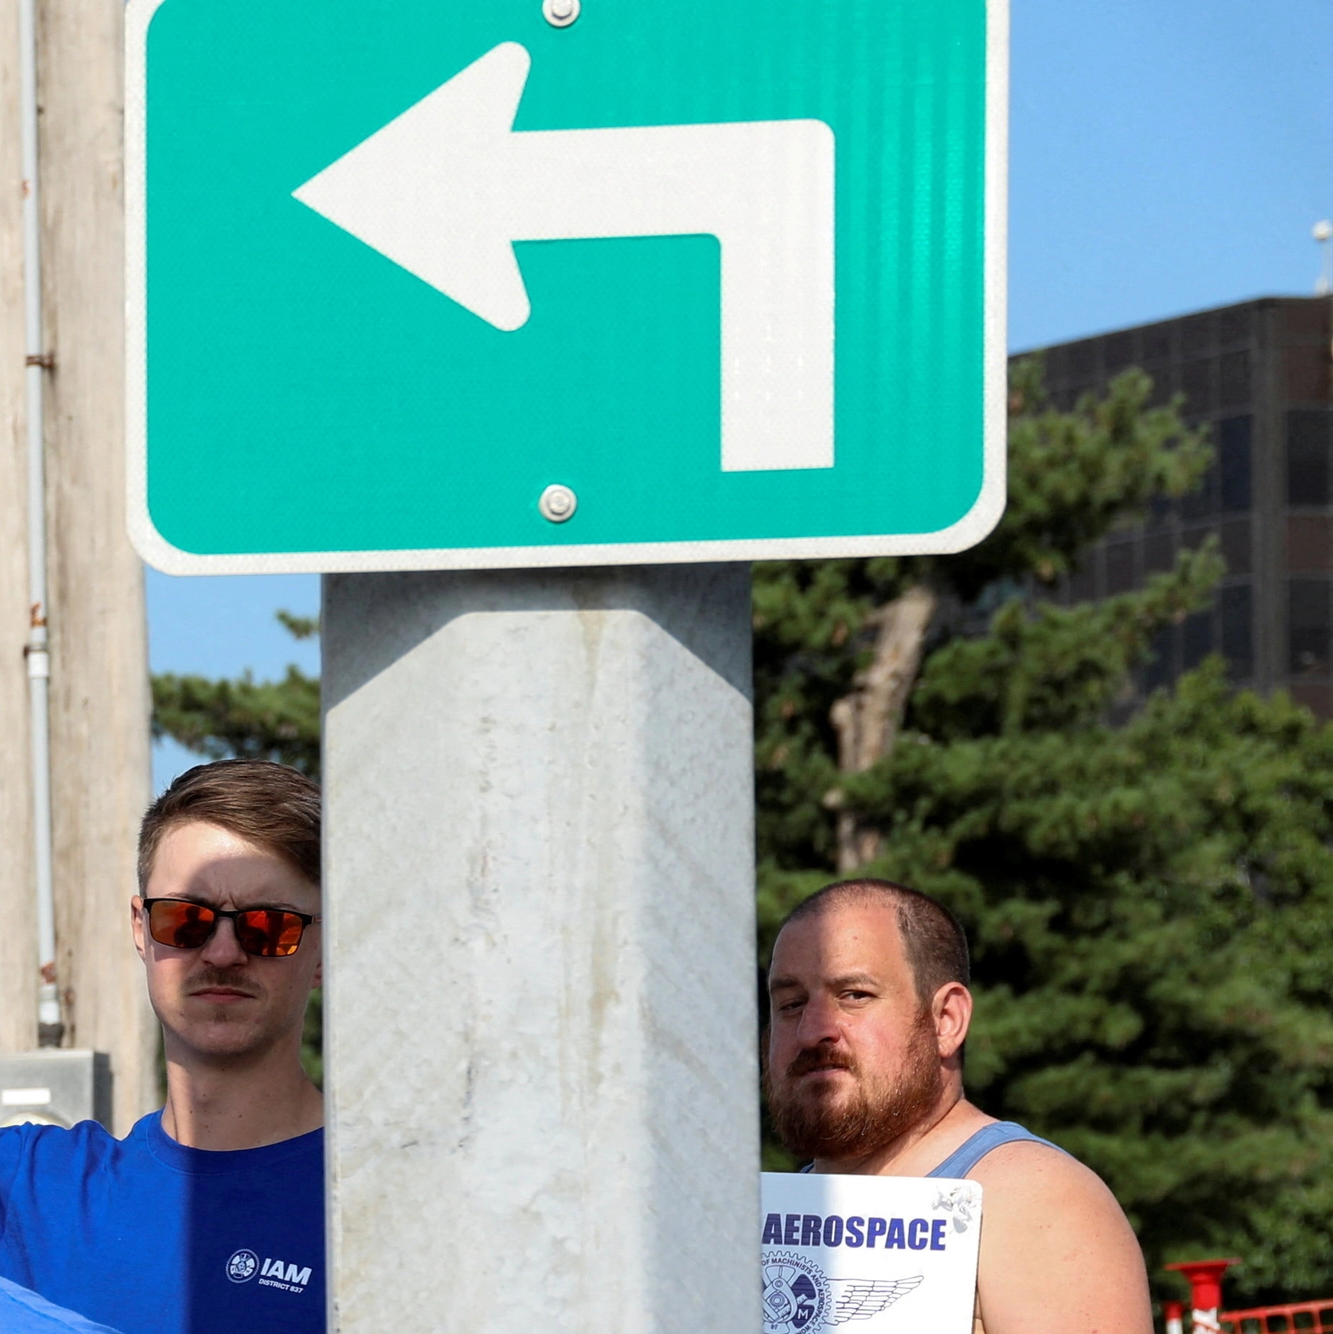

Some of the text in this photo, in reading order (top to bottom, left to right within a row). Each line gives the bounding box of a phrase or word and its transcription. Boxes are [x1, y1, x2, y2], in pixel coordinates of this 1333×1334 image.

[763, 1214, 947, 1251] AEROSPACE
[258, 1278, 290, 1291] DISTRICT
[260, 1258, 312, 1286] IAM
[771, 1257, 813, 1275] MACHINISTS
[810, 1274, 822, 1288] AND
